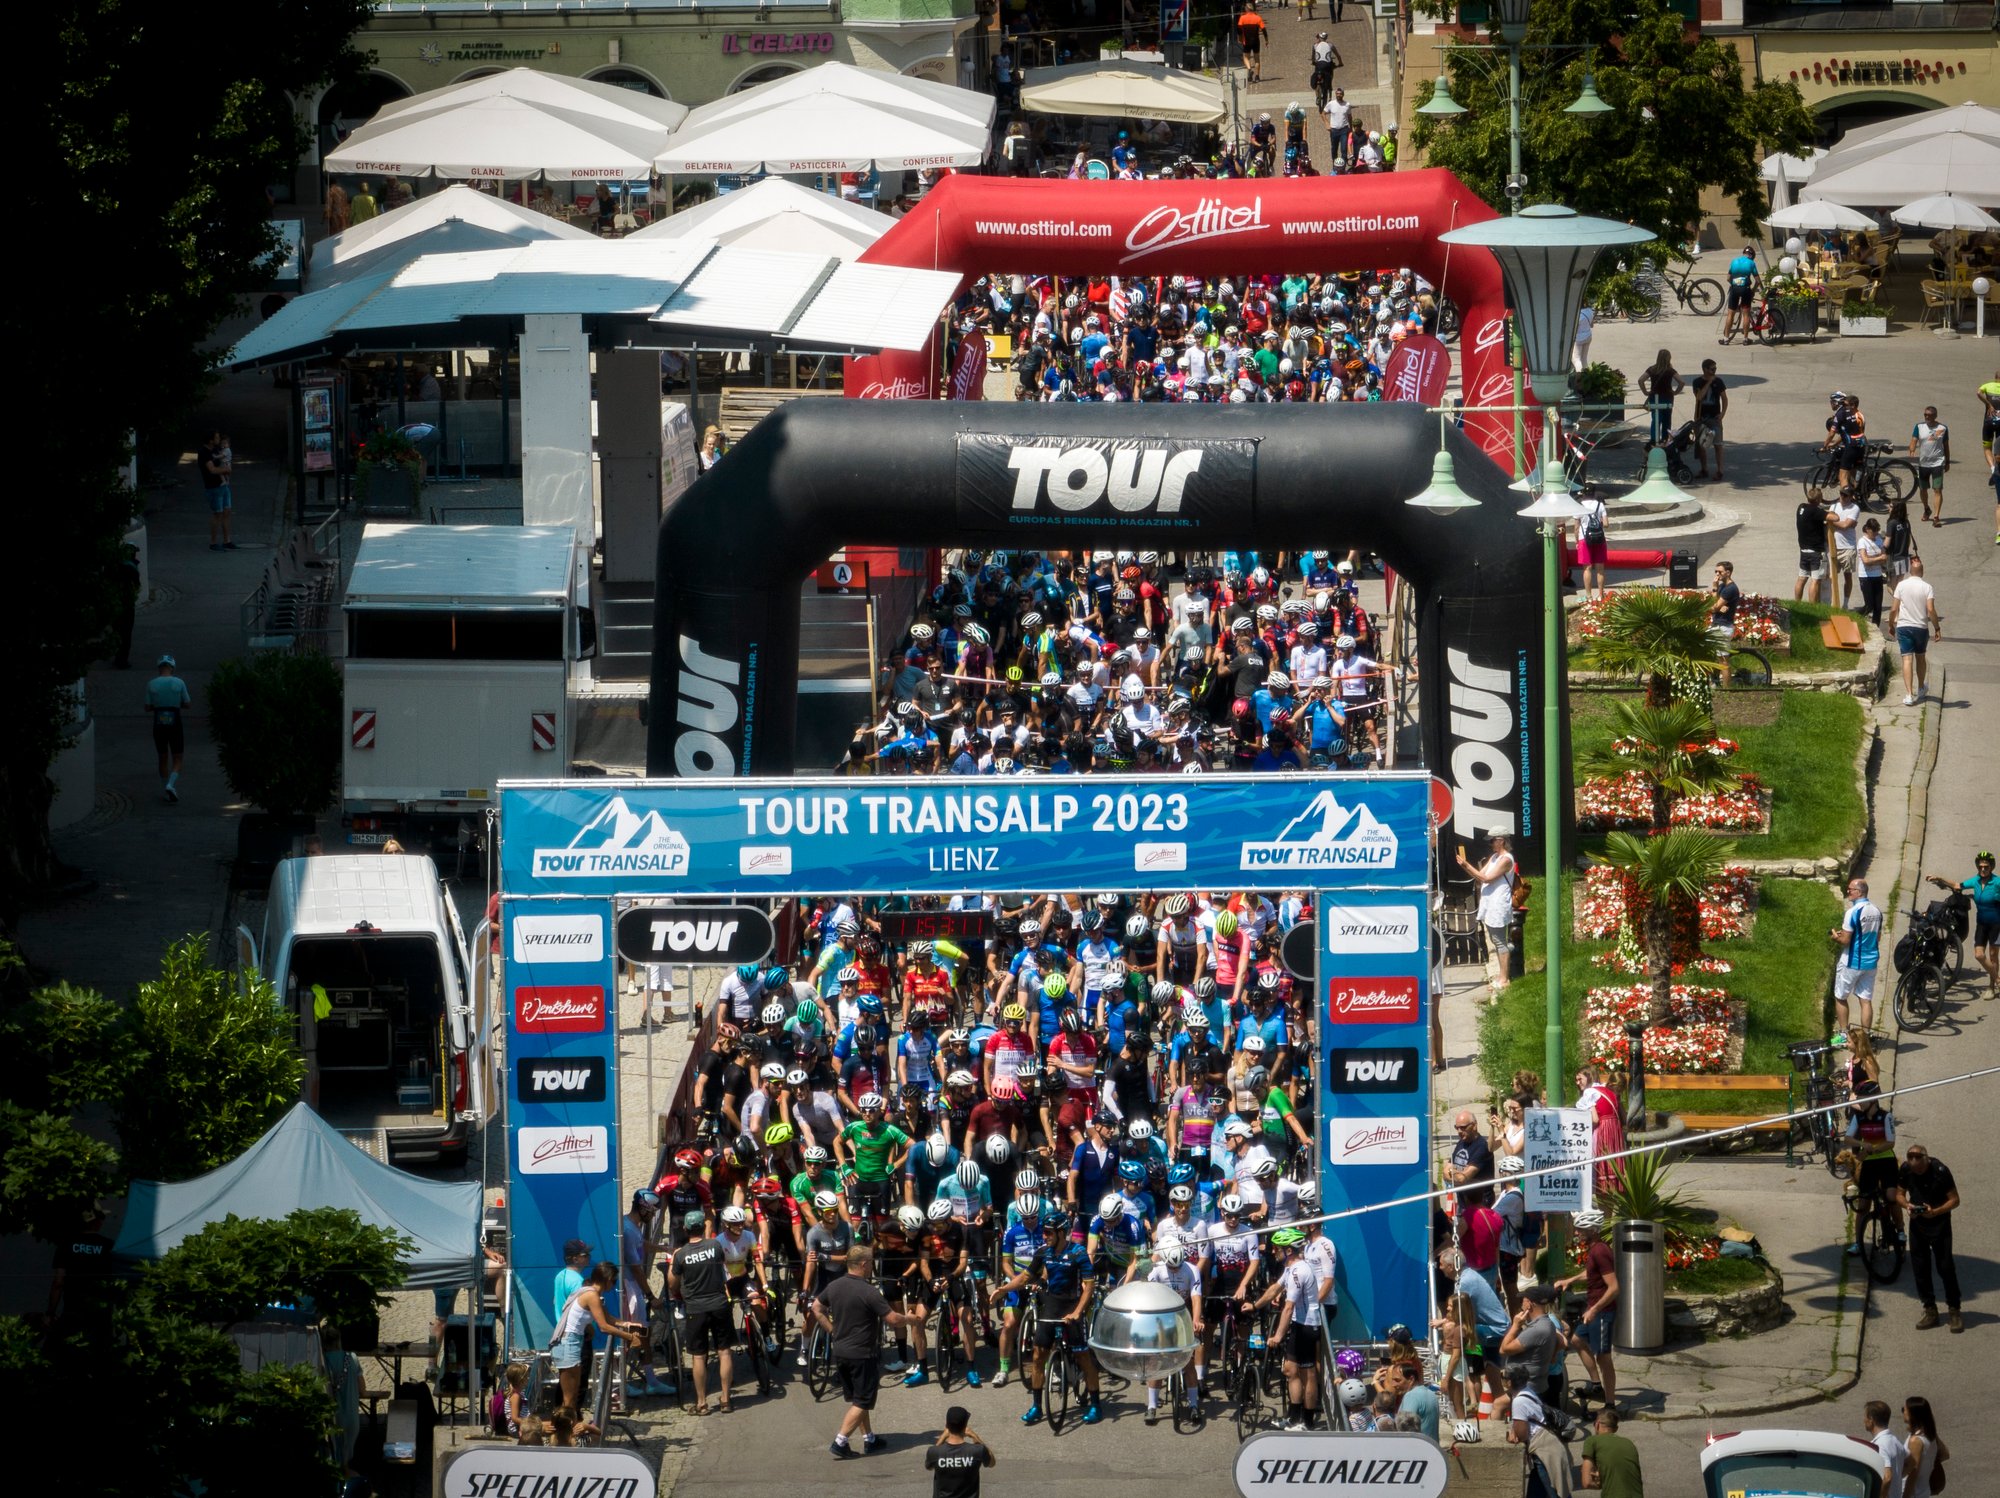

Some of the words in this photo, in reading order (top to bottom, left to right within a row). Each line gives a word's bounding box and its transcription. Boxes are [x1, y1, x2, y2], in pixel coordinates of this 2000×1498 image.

[723, 34, 741, 54] IL
[749, 32, 834, 54] GELATO
[448, 49, 545, 61] TRACHTENWELT
[685, 162, 733, 170] GELATERIA
[790, 161, 847, 170] PASTICCERIA
[903, 156, 954, 167] CONFISERIE
[471, 168, 505, 176] GLANZL
[571, 169, 624, 177] KONDITOREI
[976, 220, 1112, 237] www.osttirol.com
[1119, 196, 1270, 265] Osttirol
[1282, 214, 1419, 236] www.osttirol.com
[1009, 516, 1060, 524] EUROPAS
[1063, 517, 1117, 526] RENNRAD
[1120, 518, 1171, 526] MAGAZIN
[838, 566, 847, 581] A
[1518, 656, 1528, 675] NR.
[674, 634, 741, 778] OUR
[745, 672, 757, 724] MAGAZIN
[1519, 677, 1529, 729] MAGAZIN
[742, 725, 754, 777] RENNRAD
[1520, 731, 1530, 783] RENNRAD
[739, 797, 850, 836] TOUR
[861, 795, 1079, 834] TRANSALP
[1091, 793, 1189, 832] 2023
[1522, 784, 1532, 837] EUROPAS
[658, 836, 671, 844] THE
[590, 855, 684, 871] TRANSALP
[929, 847, 1000, 871] LIENZ
[1297, 847, 1392, 864] TRANSALP
[900, 917, 984, 936] 11:53:11
[1338, 925, 1409, 936] SPECIALIZED
[524, 933, 593, 945] SPECIALIZED
[1343, 1125, 1407, 1157] Osttirol
[1561, 1139, 1588, 1147] 25.06
[531, 1134, 596, 1166] Osttirol
[1539, 1175, 1579, 1189] Lienz
[73, 1243, 103, 1255] CREW
[684, 1248, 716, 1265] CREW
[937, 1457, 974, 1468] CREW
[1251, 1459, 1428, 1484] SPECIALIZED
[461, 1474, 638, 1498] SPECIALIZED
